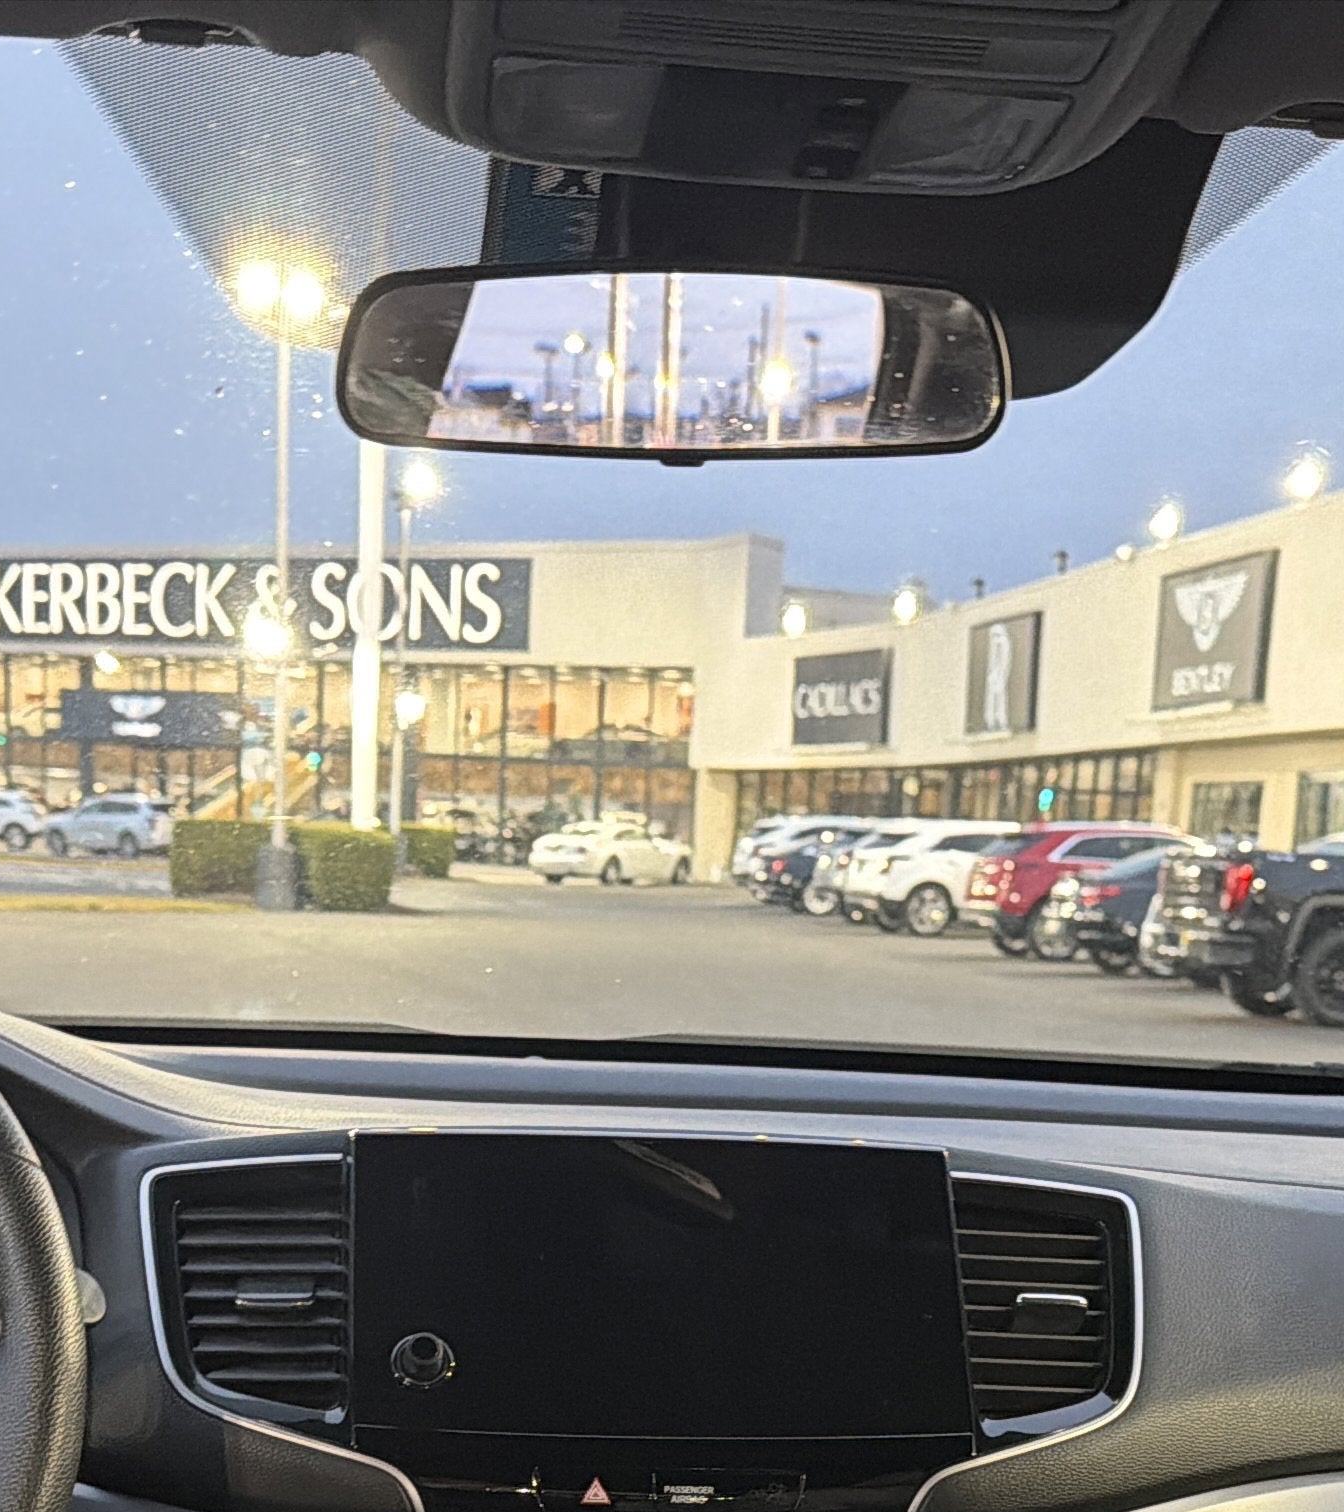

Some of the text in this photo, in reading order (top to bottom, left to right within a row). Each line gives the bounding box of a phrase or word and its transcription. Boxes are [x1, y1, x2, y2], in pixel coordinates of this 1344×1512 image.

[254, 564, 298, 634] &
[309, 561, 503, 644] SONS
[664, 1485, 714, 1494] PASSENGER
